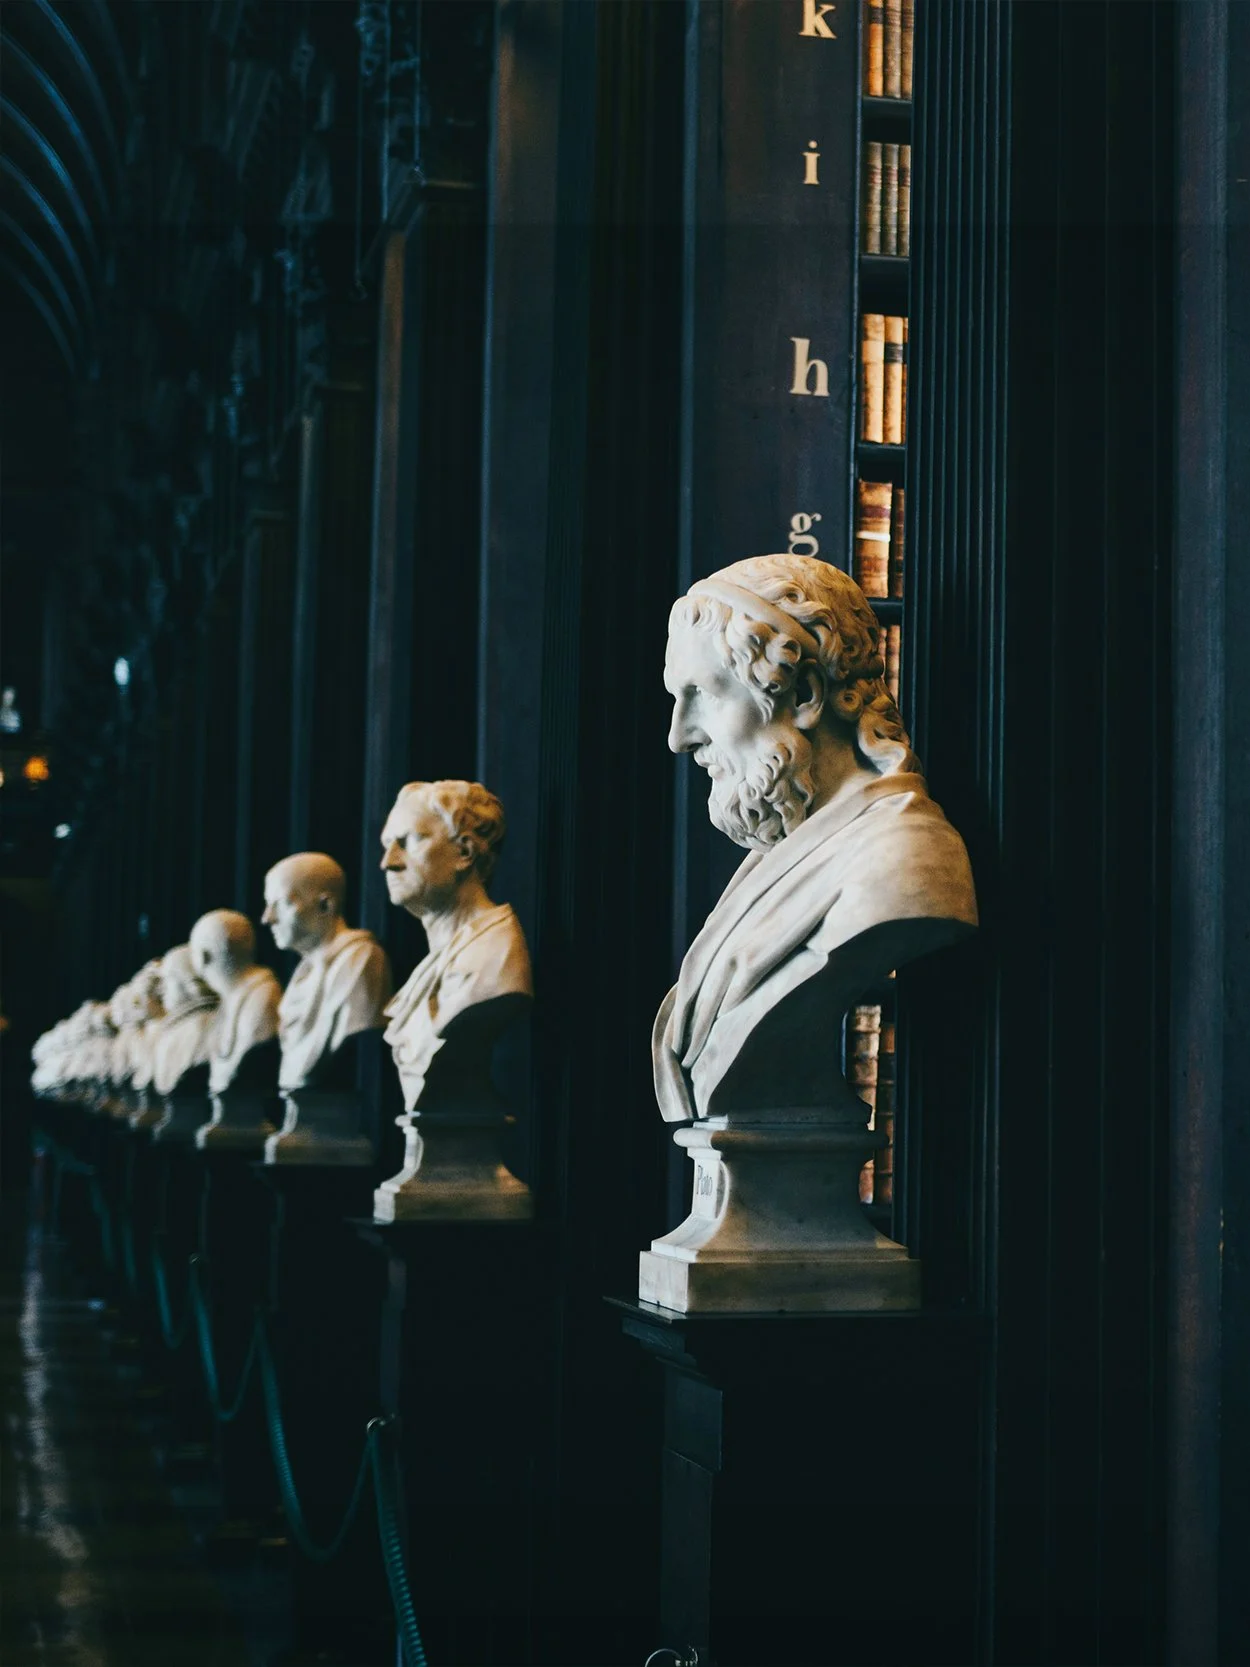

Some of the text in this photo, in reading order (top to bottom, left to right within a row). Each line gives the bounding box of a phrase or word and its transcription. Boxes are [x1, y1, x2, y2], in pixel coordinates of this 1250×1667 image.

[798, 0, 837, 39] k
[803, 141, 820, 185] i
[790, 337, 830, 397] h
[787, 512, 822, 558] g
